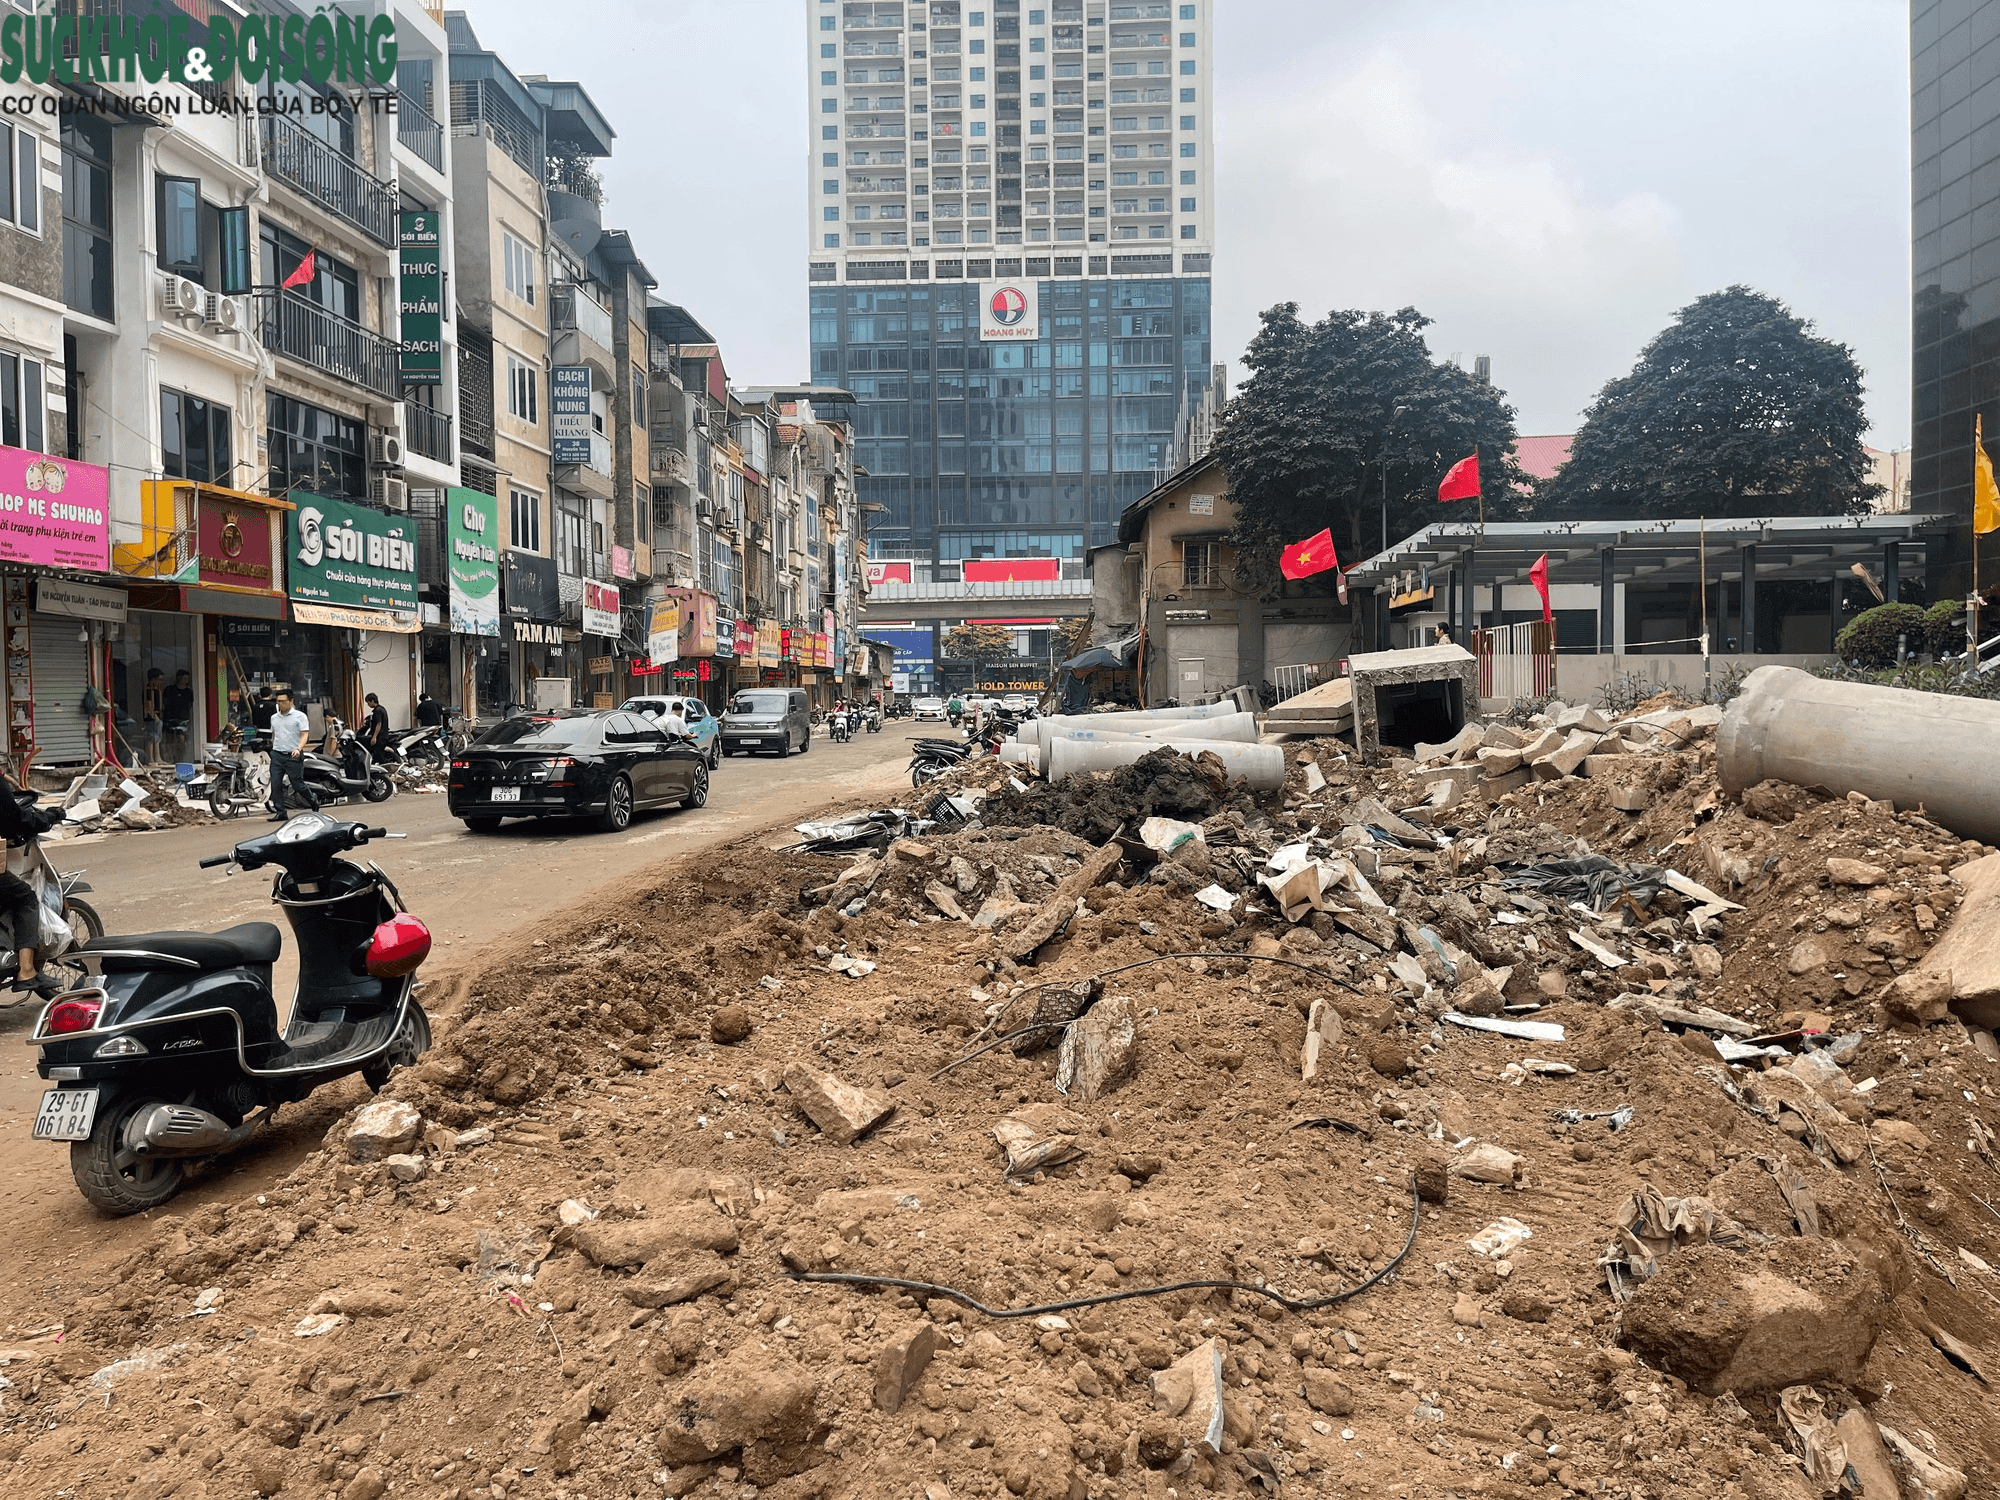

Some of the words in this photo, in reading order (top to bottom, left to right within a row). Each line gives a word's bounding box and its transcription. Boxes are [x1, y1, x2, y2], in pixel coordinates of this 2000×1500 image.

[401, 231, 414, 241] SÓI
[401, 261, 437, 278] THỰC
[402, 296, 438, 314] PHẨM
[984, 328, 1014, 337] HOANG
[1016, 328, 1034, 336] HUY
[403, 340, 439, 356] SẠCH
[557, 370, 585, 384] GẠCH
[554, 384, 588, 397] KHÔNG
[557, 401, 586, 412] NUNG
[560, 414, 583, 426] HIẾU
[555, 428, 588, 436] KHANG
[28, 497, 46, 520] MẸ
[50, 502, 102, 526] SHUHAO
[462, 503, 486, 536] Chợ
[10, 522, 34, 536] trang
[36, 526, 52, 539] phụ
[53, 528, 70, 540] kiện
[84, 534, 96, 542] em
[325, 519, 364, 564] SÓI
[366, 528, 414, 573] BIỂN
[452, 538, 480, 562] Nguyễn
[480, 544, 496, 563] Tuân
[326, 570, 344, 582] Chuỗi
[344, 572, 356, 584] cửa
[356, 575, 372, 588] hàng
[372, 577, 384, 589] thực
[384, 578, 400, 590] phẩm
[400, 582, 412, 593] sạch
[237, 624, 250, 632] SÓI
[514, 616, 543, 642] TÂM
[544, 625, 562, 644] AN
[550, 646, 562, 656] HAIR
[976, 682, 1005, 690] GOLD
[1008, 681, 1045, 690] TOWER
